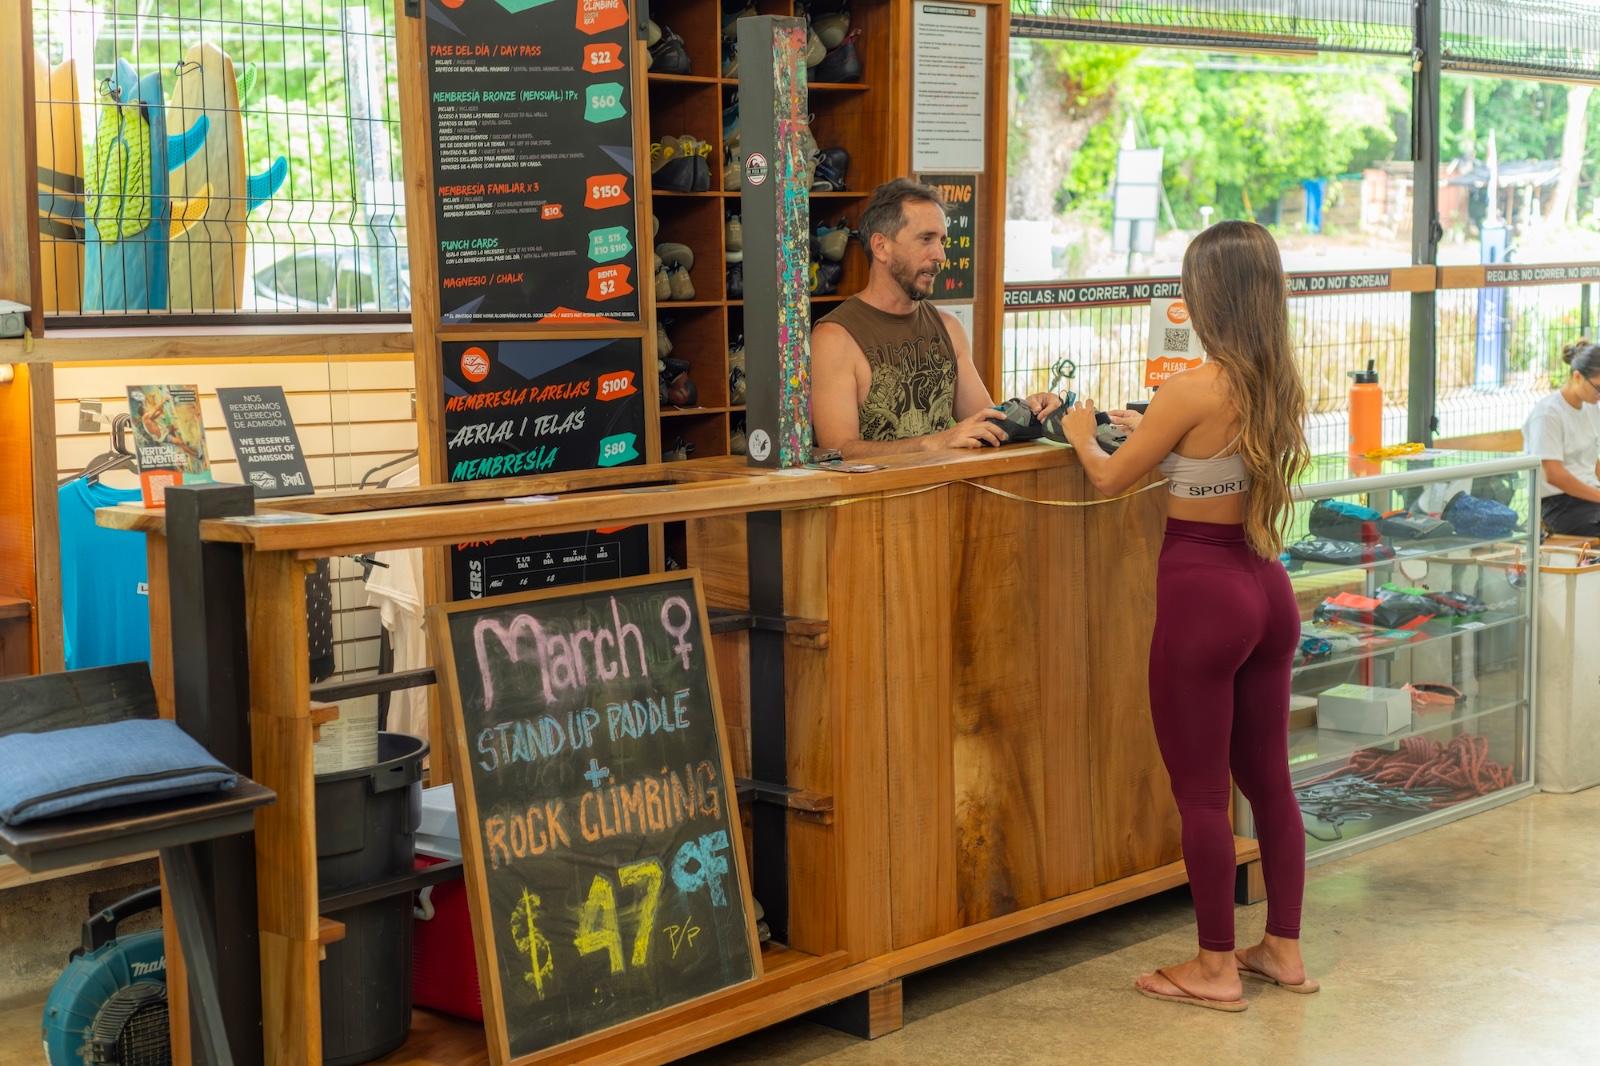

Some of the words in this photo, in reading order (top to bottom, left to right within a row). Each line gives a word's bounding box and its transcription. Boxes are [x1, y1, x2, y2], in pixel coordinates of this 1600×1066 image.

[430, 45, 454, 56] PASE
[456, 45, 472, 56] DEL
[475, 43, 490, 56] DÍA
[500, 45, 518, 56] DAY
[520, 44, 542, 56] PASS
[590, 52, 611, 65] $22
[433, 88, 480, 102] MEMBRESÍA
[483, 90, 516, 101] BRONZE
[520, 89, 563, 102] (MENSUAL)
[592, 96, 616, 108] $60
[439, 182, 485, 196] MEMBRESÍA
[488, 183, 526, 194] FAMILIAR
[534, 183, 539, 192] 3
[592, 185, 621, 199] $150
[442, 240, 470, 251] PUNCH
[472, 238, 498, 248] CARDS
[960, 236, 970, 248] V3
[960, 258, 970, 270] V5
[444, 275, 486, 288] MAGNESIO
[496, 272, 524, 284] CHALK
[598, 268, 618, 279] RENTA
[1487, 270, 1520, 282] REGLAS:
[1521, 269, 1533, 280] NO
[1534, 268, 1567, 280] CORRER,
[1568, 268, 1579, 278] NO
[600, 280, 615, 295] $2
[1285, 278, 1308, 292] RUN,
[1311, 277, 1325, 289] DO
[1327, 276, 1347, 289] NOT
[1349, 274, 1388, 288] SCREAM
[1004, 290, 1054, 304] REGLAS:
[1058, 288, 1076, 302] NO
[1079, 286, 1130, 300] CORRER,
[1133, 284, 1150, 298] NO
[529, 378, 592, 403] PAREJAS
[602, 377, 628, 395] $100
[229, 402, 280, 411] RESERVAMOS
[233, 412, 242, 420] EL
[244, 411, 282, 419] DERECHO
[247, 418, 286, 428] ADMISIÓN
[449, 418, 516, 449] AERIAL
[534, 406, 587, 437] TELAS
[240, 438, 253, 446] WE
[256, 436, 291, 444] RESERVE
[604, 441, 626, 459] $80
[248, 454, 294, 462] ADMISSION
[1189, 480, 1243, 496] SPORT
[563, 555, 587, 563] SEMANA
[474, 596, 648, 711] March
[477, 714, 565, 772] STAND
[568, 707, 600, 751] UP
[606, 688, 690, 742] PADDLE
[485, 800, 570, 870] ROCK
